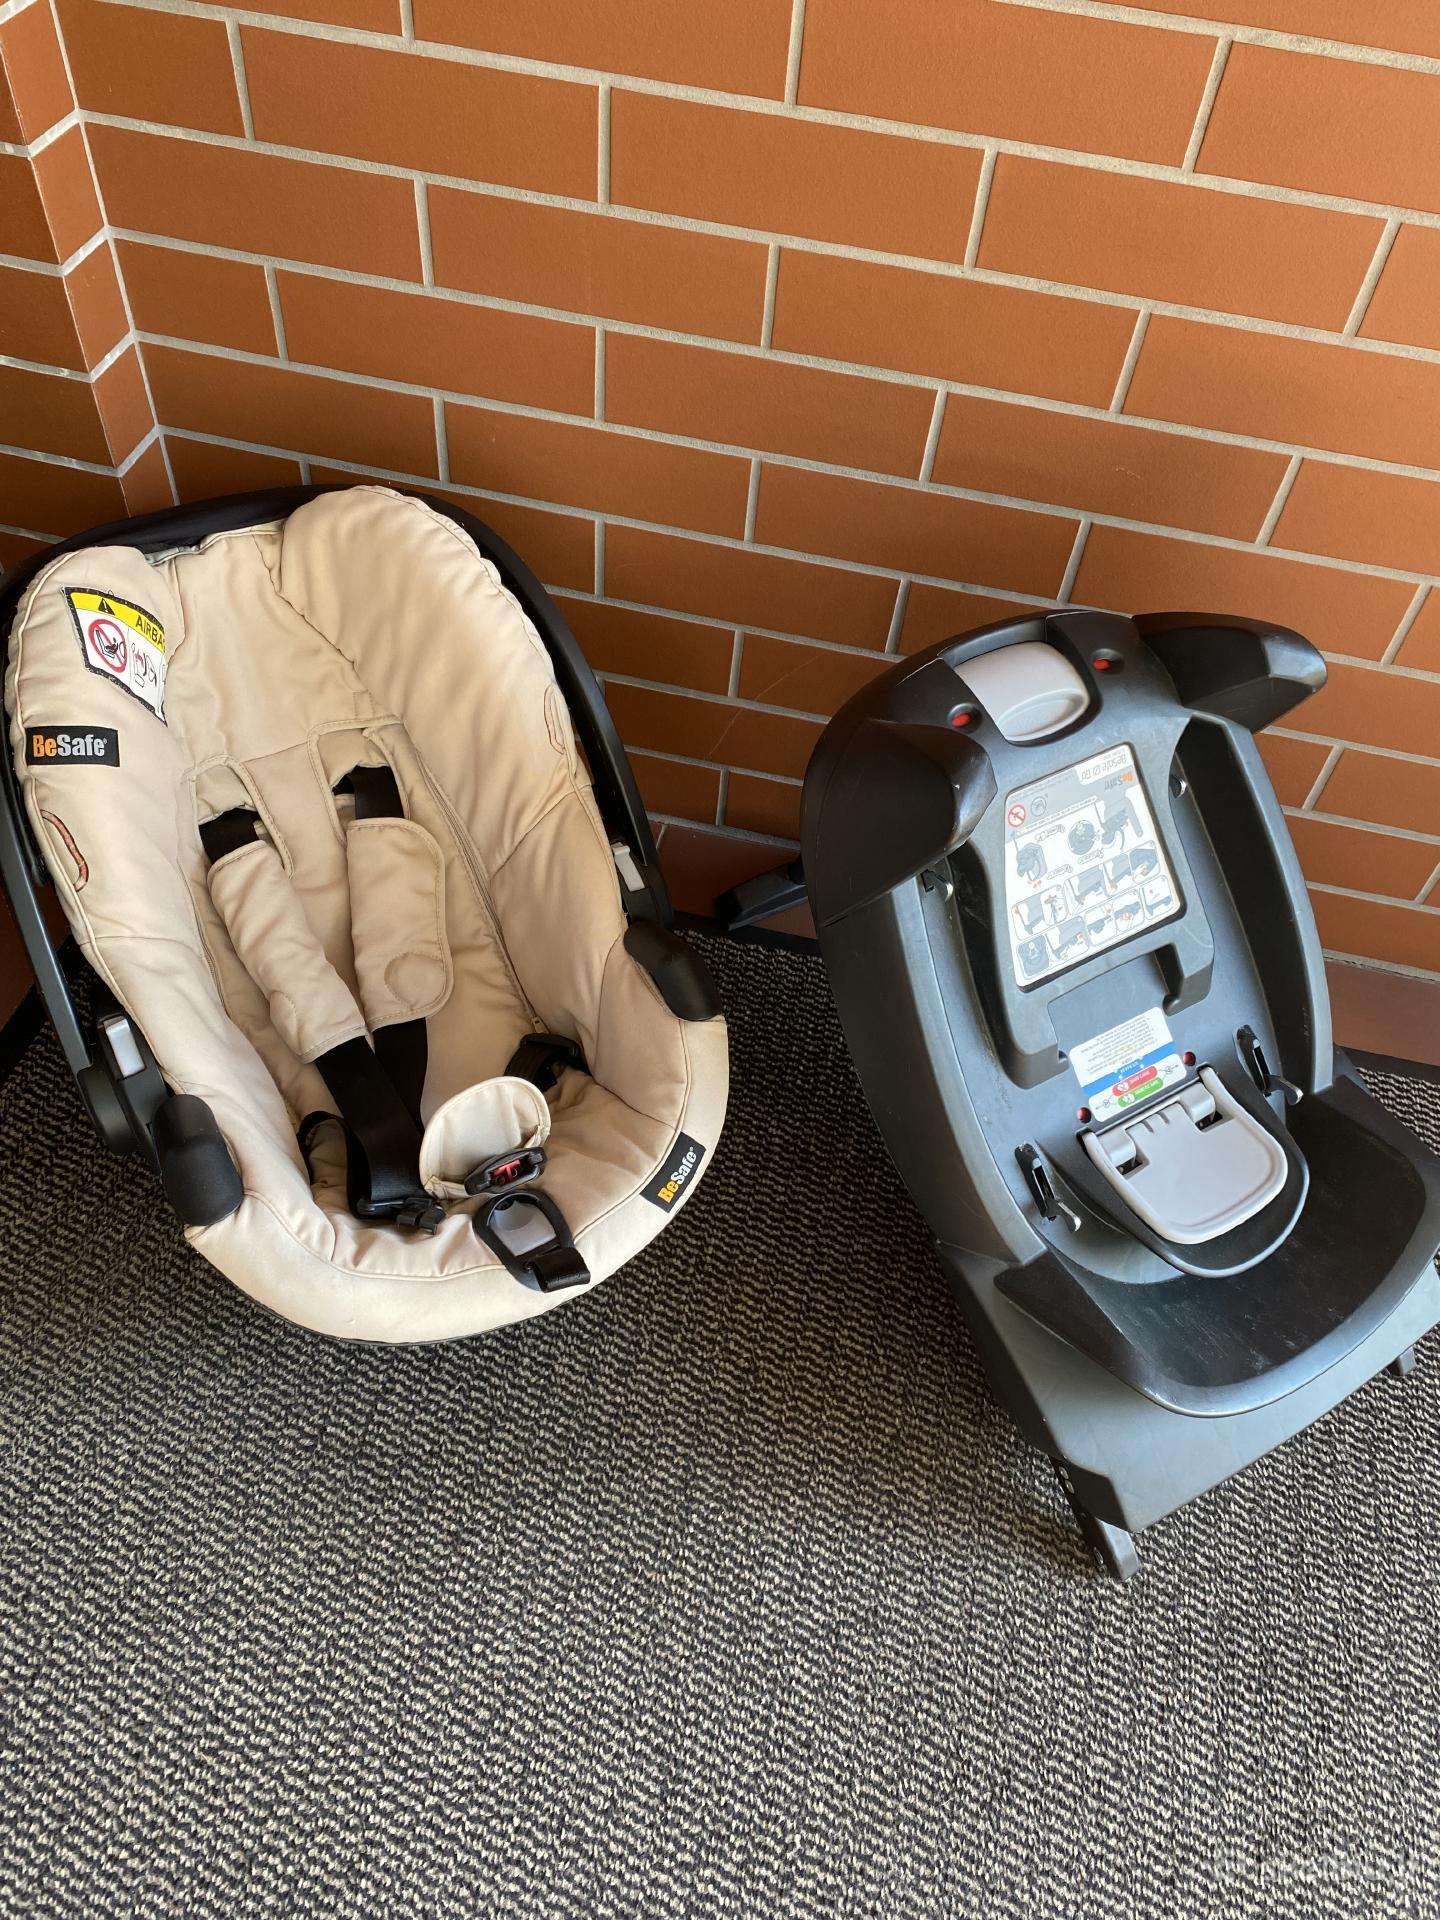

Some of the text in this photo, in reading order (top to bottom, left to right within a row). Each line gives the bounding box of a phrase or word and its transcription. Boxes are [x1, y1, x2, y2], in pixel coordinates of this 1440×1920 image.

[136, 614, 166, 648] AIRBA
[33, 733, 106, 757] BeSafe
[656, 1148, 697, 1204] BeSafe
